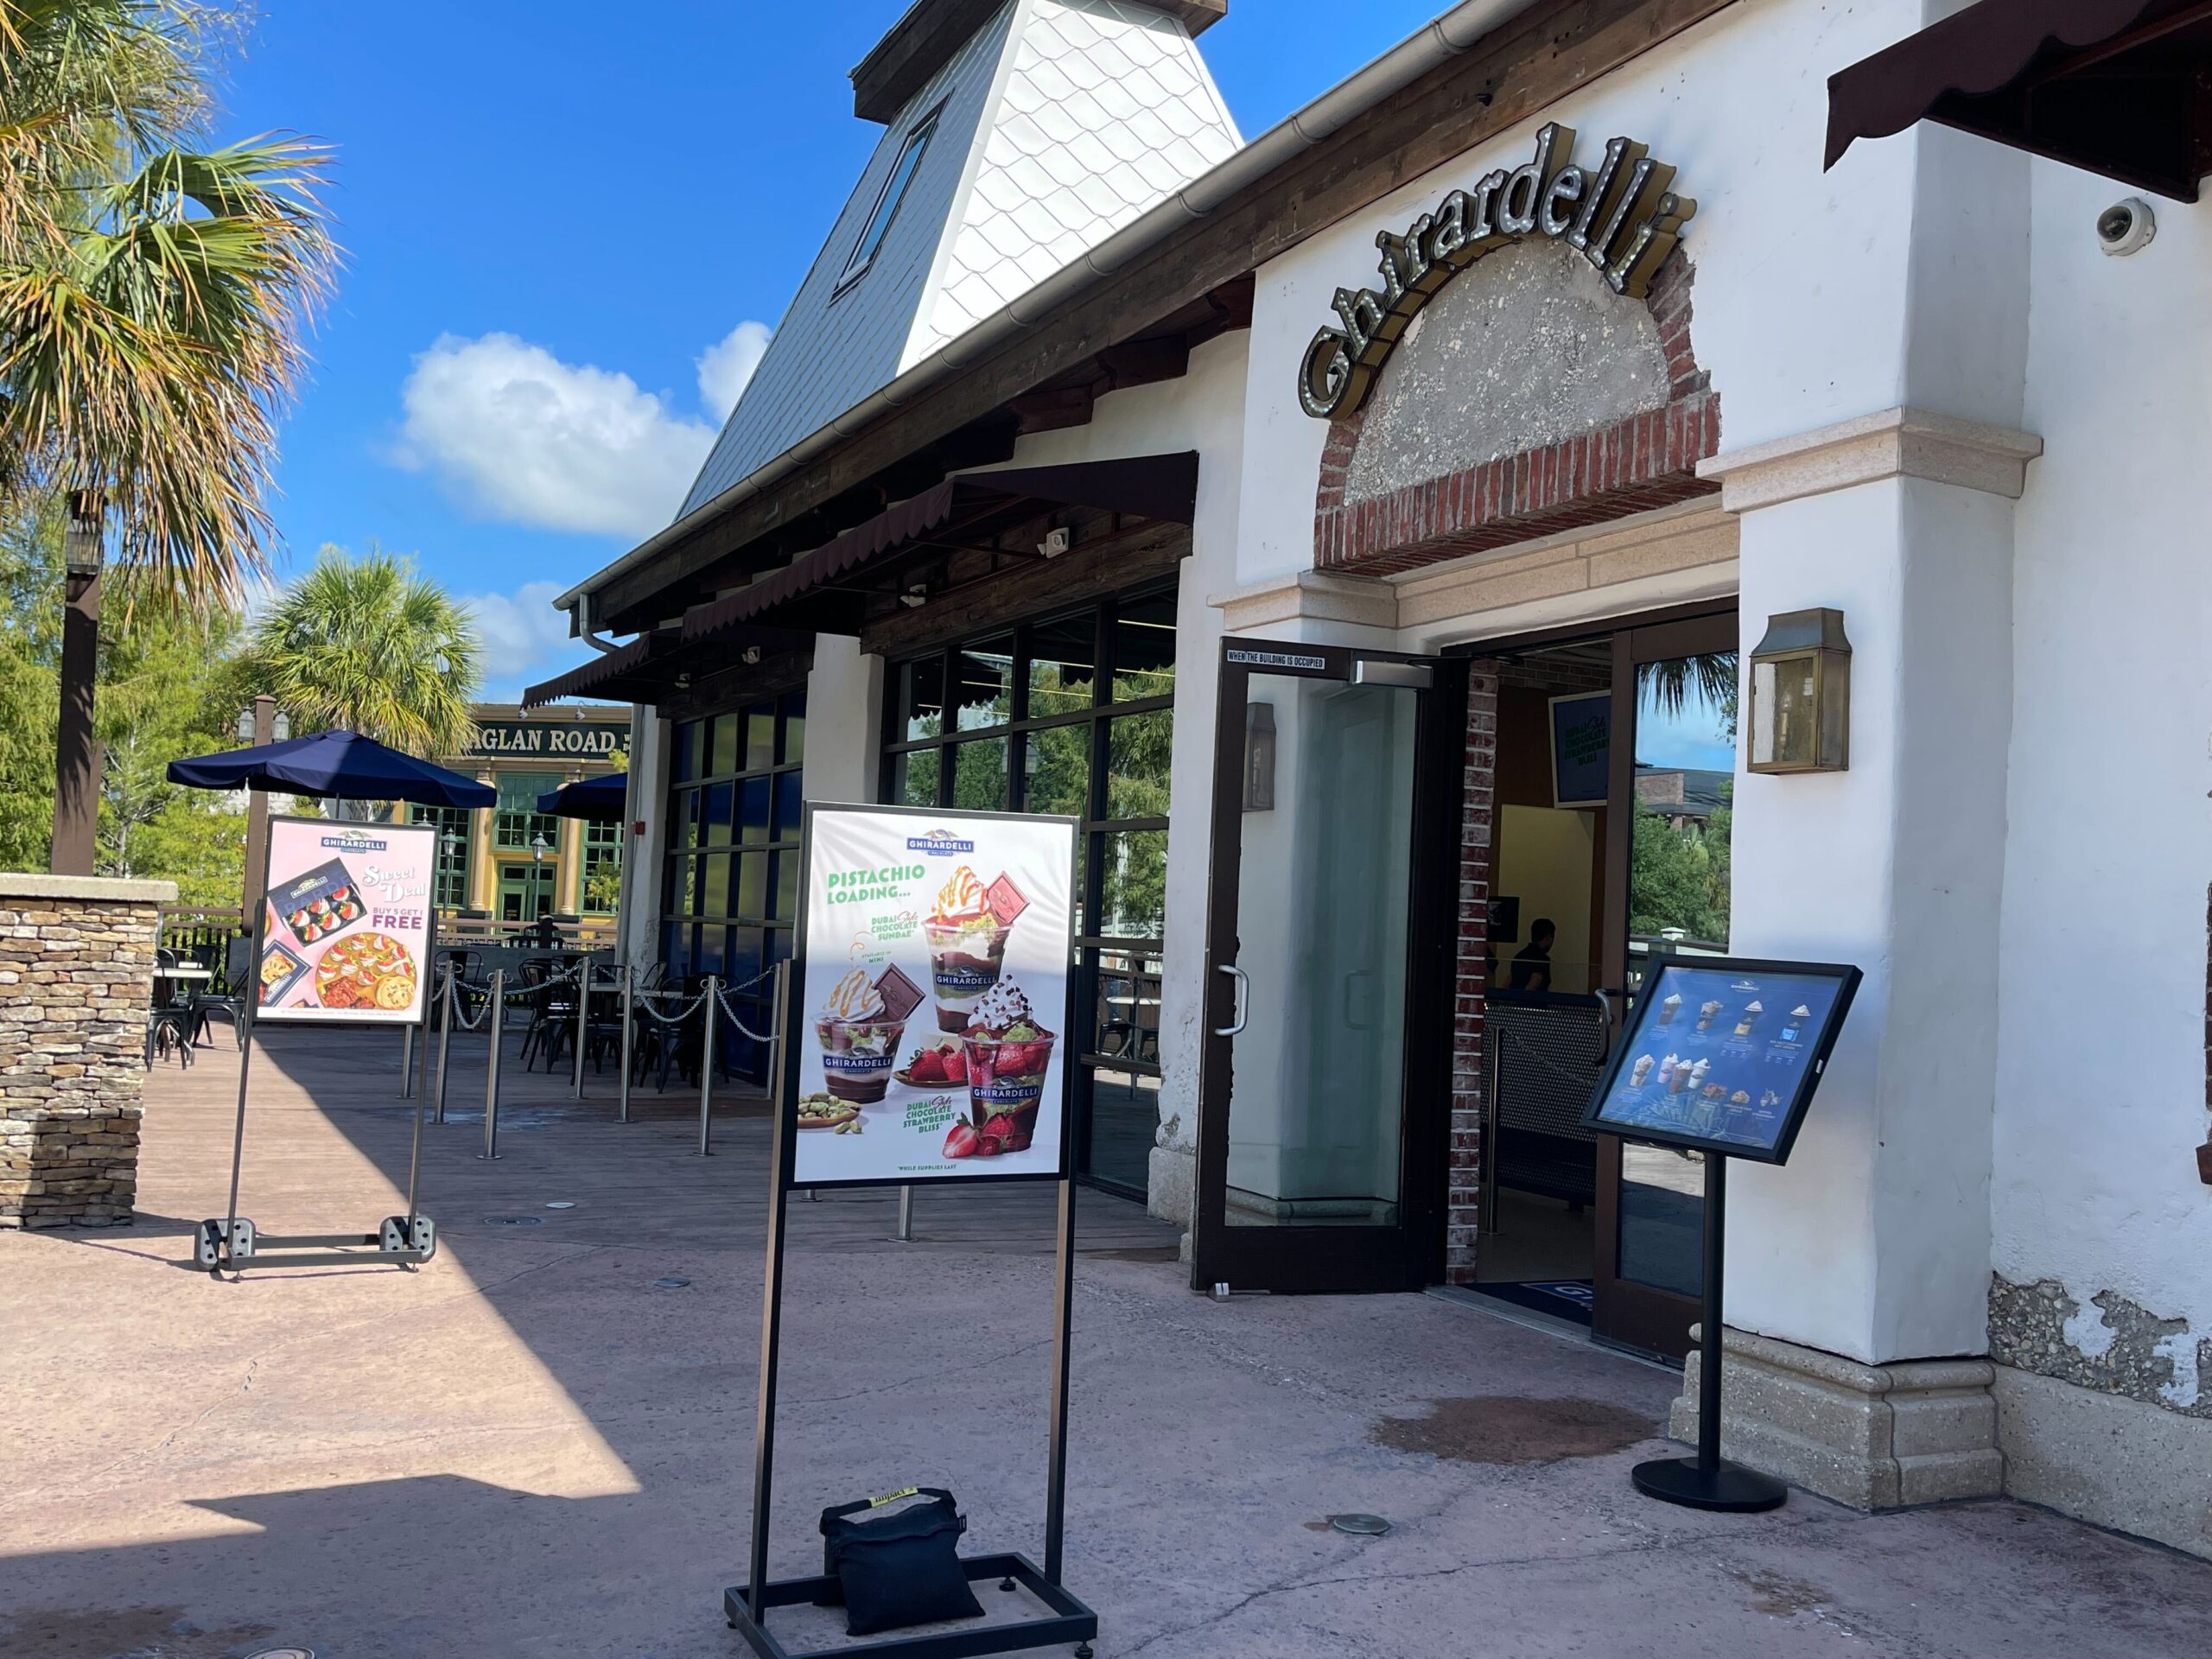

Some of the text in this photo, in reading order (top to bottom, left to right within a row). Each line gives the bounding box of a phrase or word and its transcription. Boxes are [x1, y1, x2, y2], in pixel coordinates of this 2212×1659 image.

[1298, 121, 1697, 421] Ghirardelli
[1229, 652, 1323, 668] WHEN THE BUILDING IS OCCUPIED
[467, 728, 616, 753] AGLAN ROAD
[323, 839, 385, 849] GHIRARDELLI
[909, 840, 971, 851] GHIRARDELLI
[363, 866, 415, 887] Sweet
[828, 864, 925, 888] PISTACHIO
[378, 883, 426, 903] Deal
[827, 886, 911, 905] LOADING...
[372, 915, 422, 930] FREE
[871, 911, 918, 925] DUBAI Style
[871, 921, 918, 933] CHOCOLATE
[937, 976, 995, 984] GHIRARDELLI
[825, 1058, 891, 1067] GHIRARDELLI
[974, 1088, 1037, 1097] GHIRARDELLI
[906, 1095, 952, 1111] DUBAI Style
[903, 1112, 956, 1128] STRAWBERRY
[906, 1105, 952, 1120] CHOCOLATE
